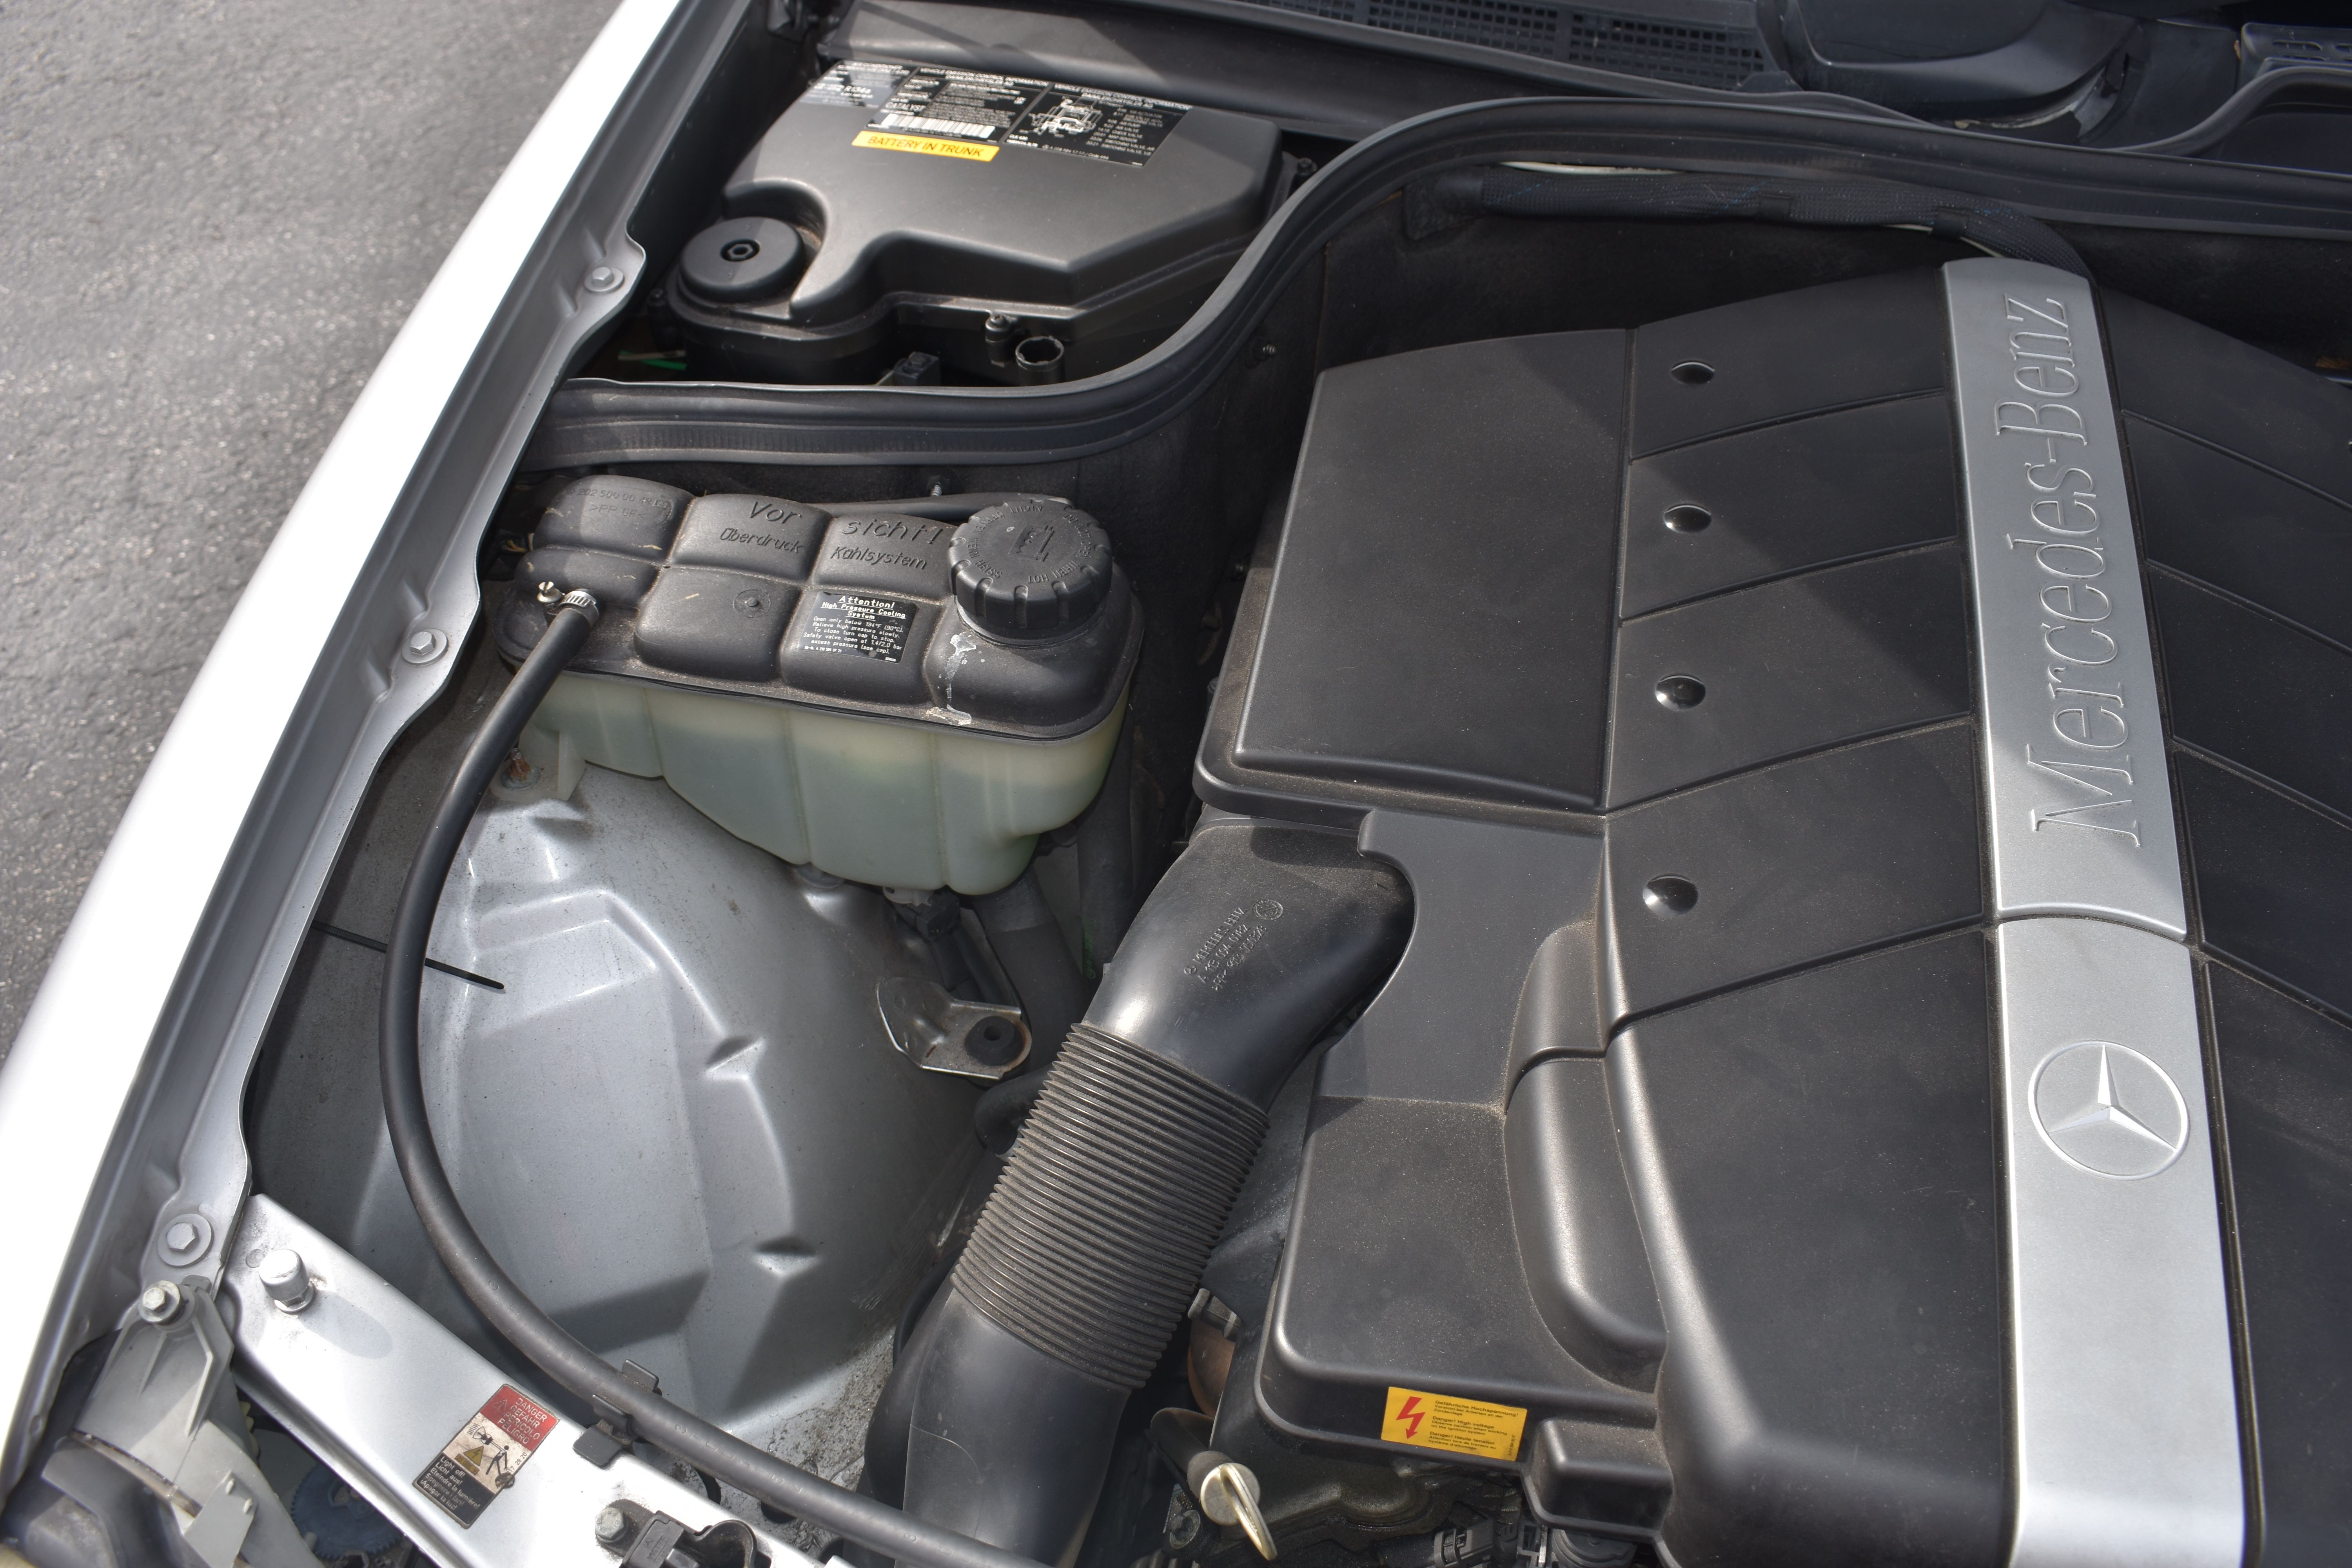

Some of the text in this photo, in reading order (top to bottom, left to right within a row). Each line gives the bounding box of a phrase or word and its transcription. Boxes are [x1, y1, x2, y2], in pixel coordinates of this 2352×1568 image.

[1005, 76, 1049, 87] INFORMATION
[885, 102, 927, 112] CATALYST
[1054, 83, 1080, 92] VEHICLE
[1112, 93, 1143, 102] CONTROL
[1144, 98, 1193, 111] INFORMATION
[867, 136, 984, 156] BATTERY IN TRUNK
[599, 491, 620, 499] 500
[1010, 505, 1043, 514] NICHT
[750, 501, 943, 544] Vor sicht!
[1077, 523, 1093, 539] NOT
[720, 528, 804, 554] Überdruck
[967, 538, 979, 559] WENN
[975, 559, 1003, 579] HEISS
[1027, 573, 1049, 584] HOT
[1052, 560, 1080, 578] WHEN
[1994, 293, 2140, 848] Mercedes-Benz
[838, 595, 895, 610] Attention!
[841, 604, 874, 613] Pressure
[878, 609, 906, 619] Cooling
[847, 611, 875, 620] System
[871, 640, 891, 648] 1.4/2.0
[1192, 926, 1229, 965] MERCEDES
[1224, 907, 1248, 926] BENZ
[510, 1405, 540, 1429] GEFAHR
[515, 1397, 548, 1423] DANGER
[1434, 1408, 1463, 1416] Zündanlage
[1435, 1400, 1518, 1417] Gefährliche Hochspannung!
[497, 1418, 530, 1444] PELIGRO
[504, 1412, 540, 1440] PERICOLO
[435, 1461, 463, 1485] Licht aus!
[440, 1456, 466, 1478] Light off!
[425, 1473, 450, 1495] Spegnere
[451, 1494, 465, 1506] fari!
[446, 1499, 458, 1510] luz!
